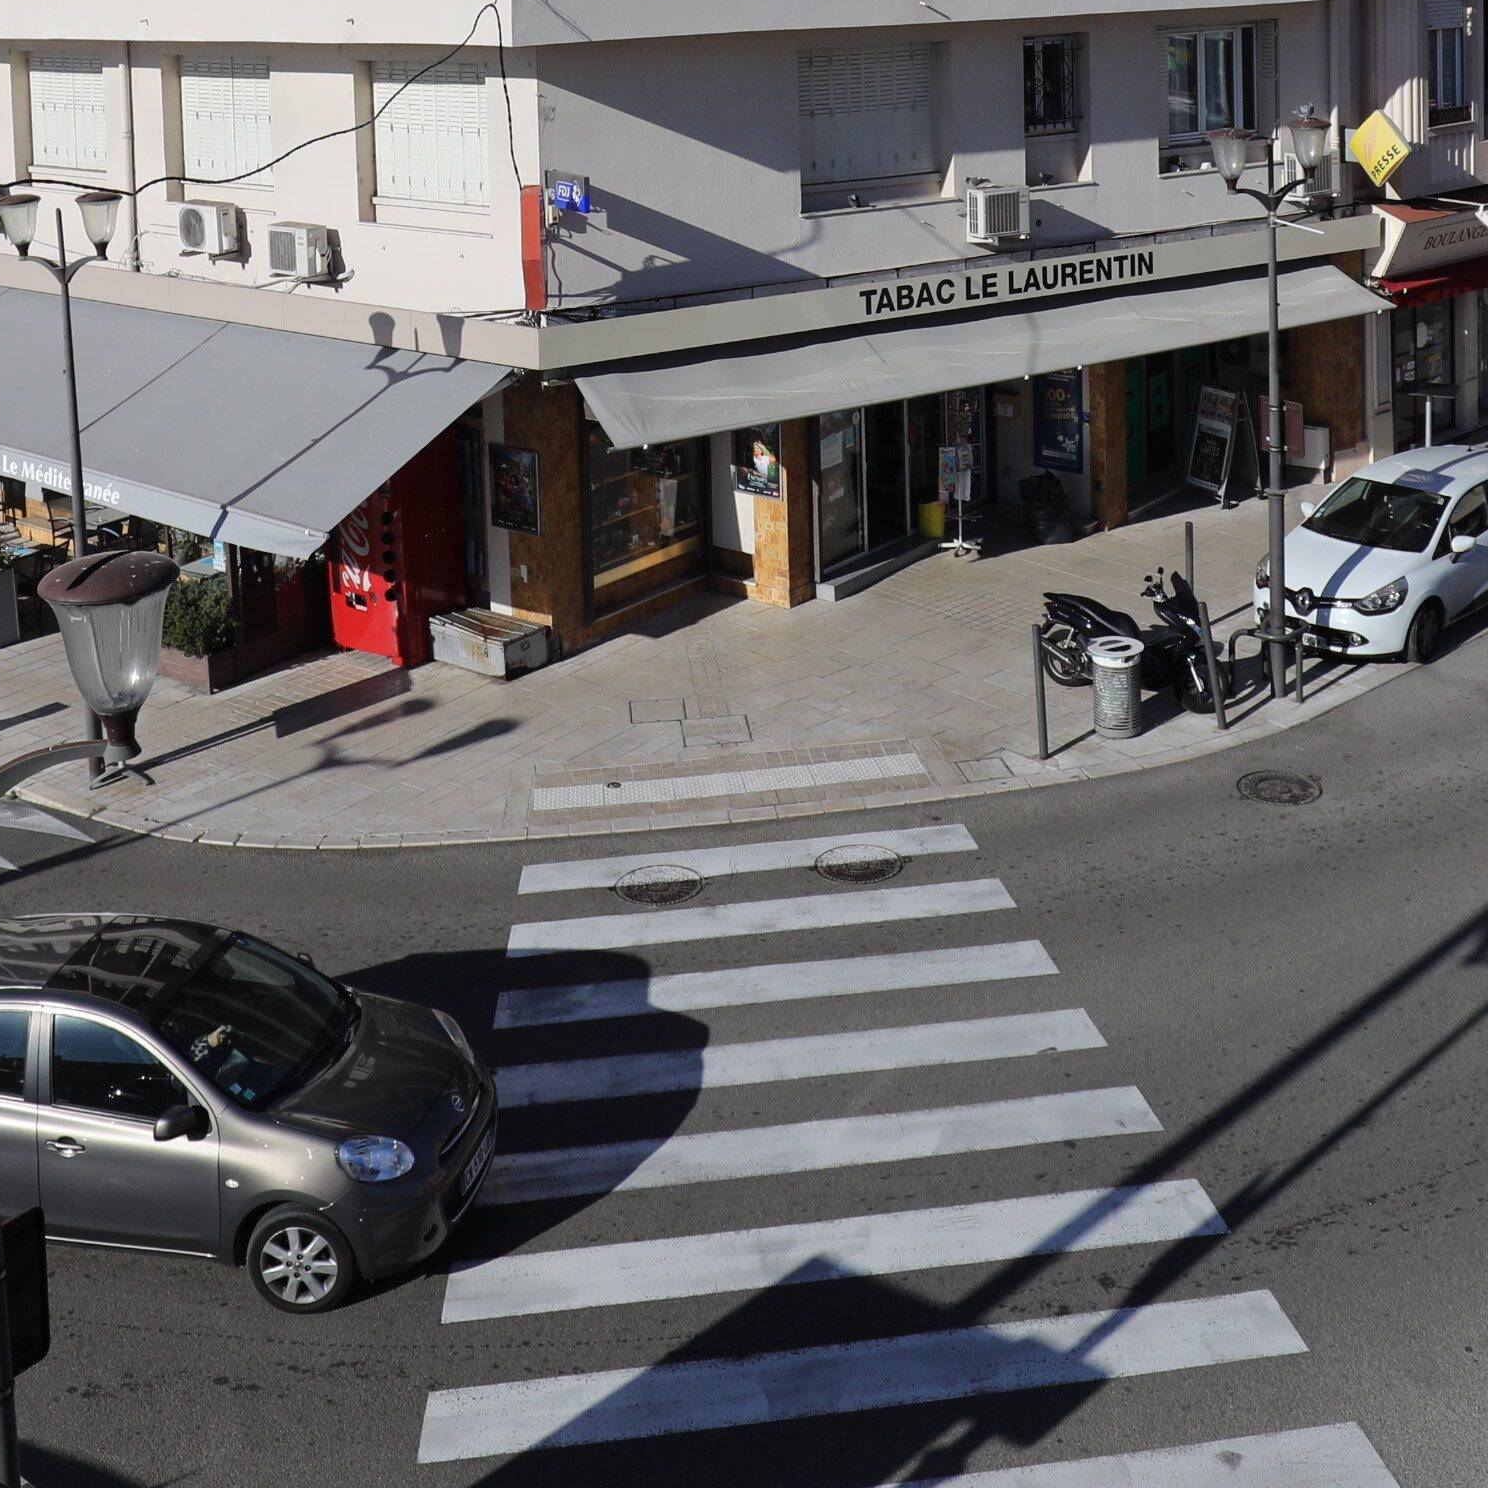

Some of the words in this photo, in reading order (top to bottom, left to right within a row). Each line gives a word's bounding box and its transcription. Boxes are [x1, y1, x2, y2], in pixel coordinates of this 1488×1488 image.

[1371, 144, 1401, 179] PRESSE
[557, 185, 571, 198] FDJ
[859, 279, 955, 316] TABAC
[965, 273, 998, 301] LE
[1008, 251, 1154, 295] LAURENTIN
[1, 454, 19, 476] Le
[21, 461, 121, 505] Méditeanée
